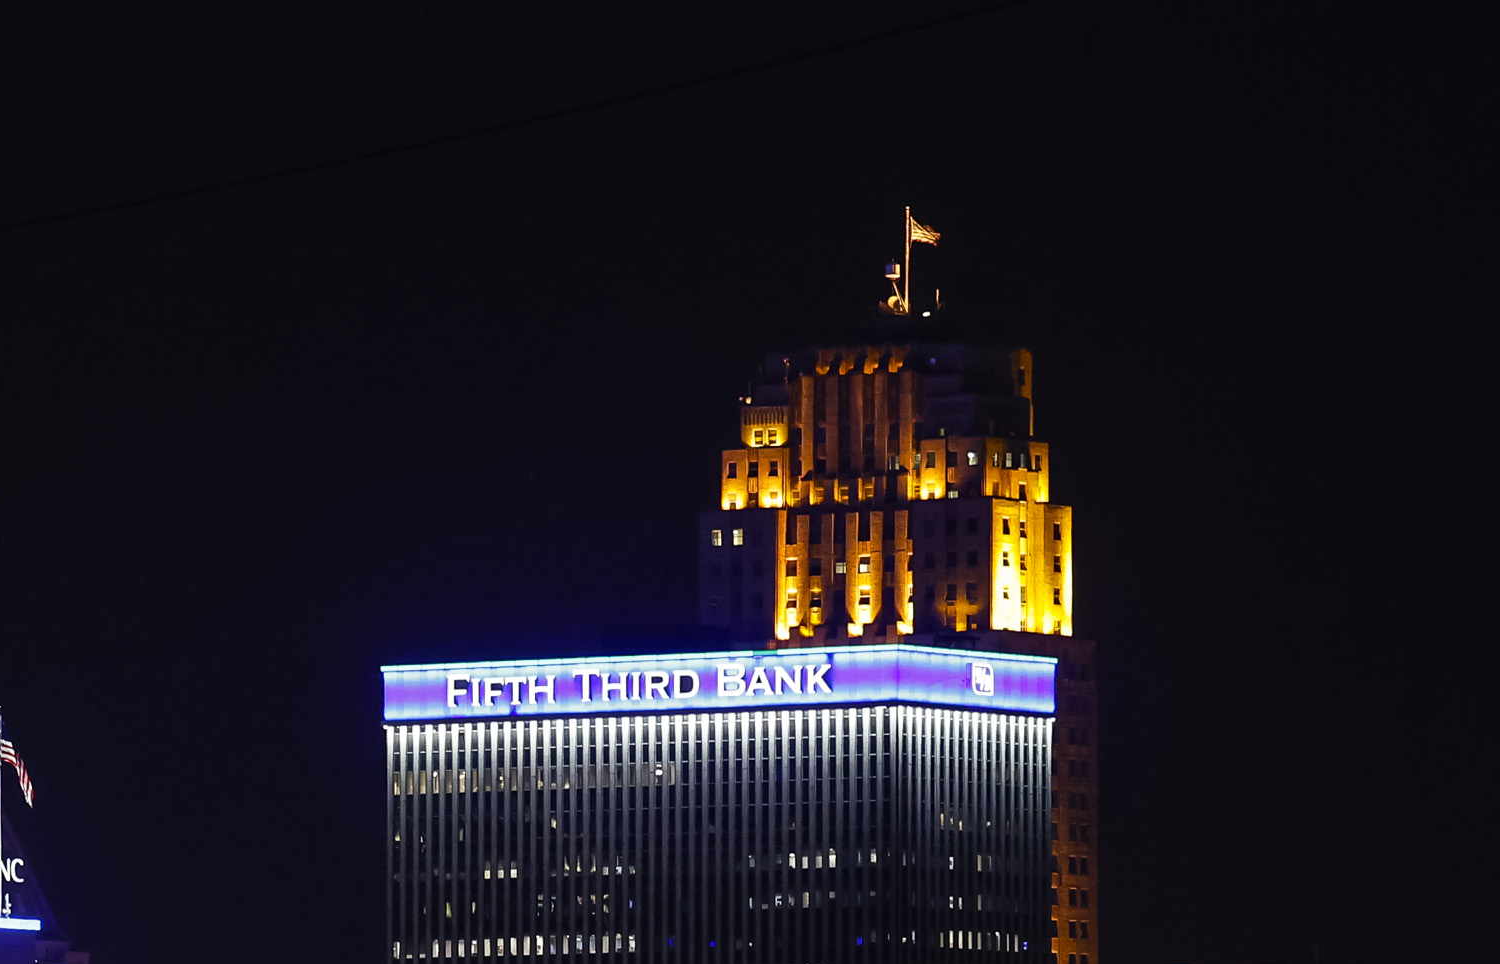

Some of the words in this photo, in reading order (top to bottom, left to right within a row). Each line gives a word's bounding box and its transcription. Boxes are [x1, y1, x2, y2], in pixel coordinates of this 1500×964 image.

[445, 673, 557, 708] FIFTH
[572, 667, 701, 702] THIRD
[716, 662, 833, 697] BANK
